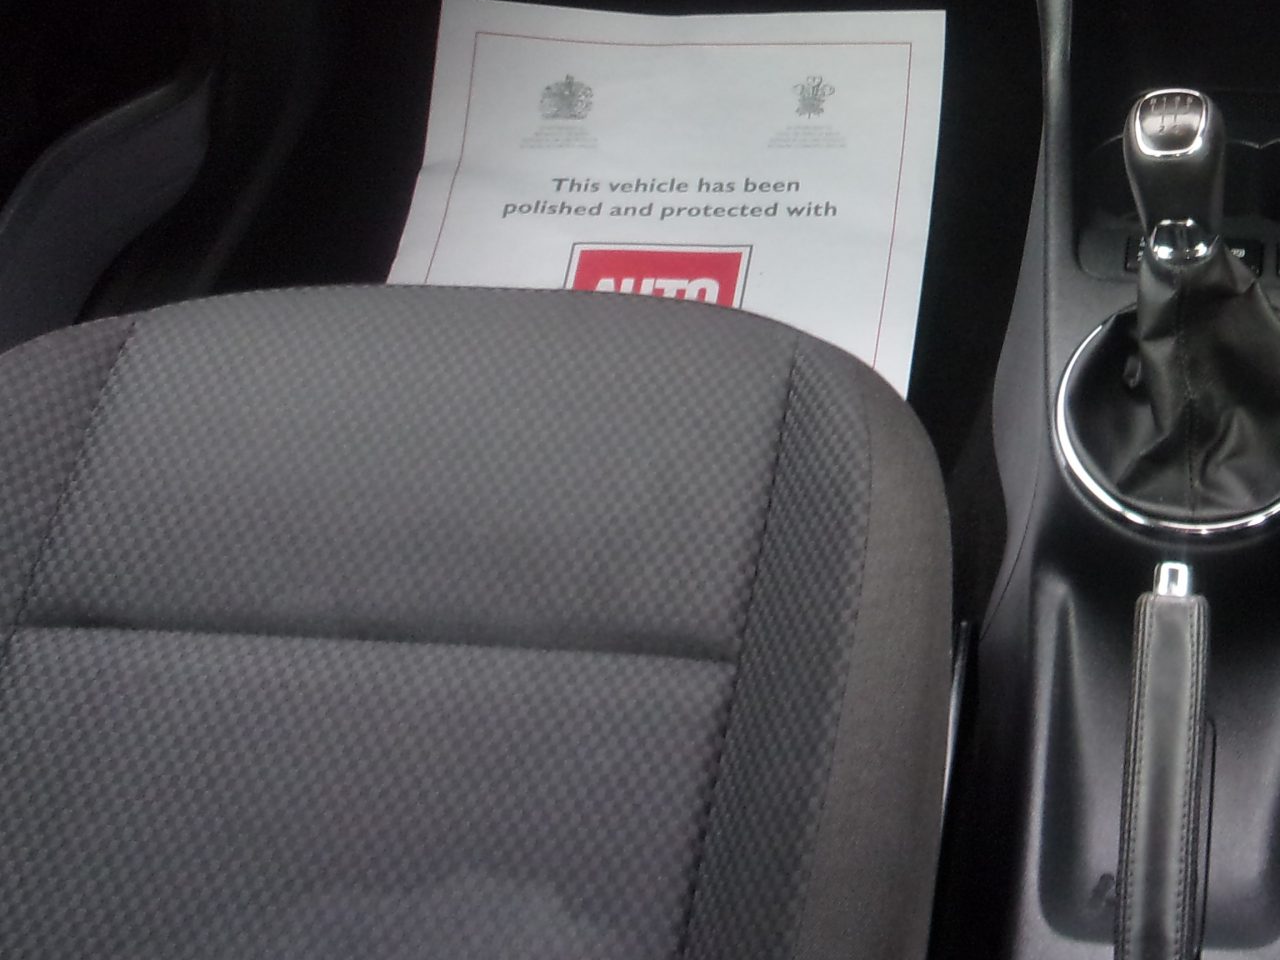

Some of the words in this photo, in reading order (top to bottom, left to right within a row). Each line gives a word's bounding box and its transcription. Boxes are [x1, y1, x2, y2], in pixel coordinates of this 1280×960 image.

[552, 178, 600, 193] This
[609, 178, 689, 193] vehicle
[697, 178, 735, 193] has
[744, 177, 801, 193] been
[502, 200, 603, 219] polished
[609, 202, 654, 217] and
[660, 202, 779, 221] protected
[786, 201, 837, 217] with
